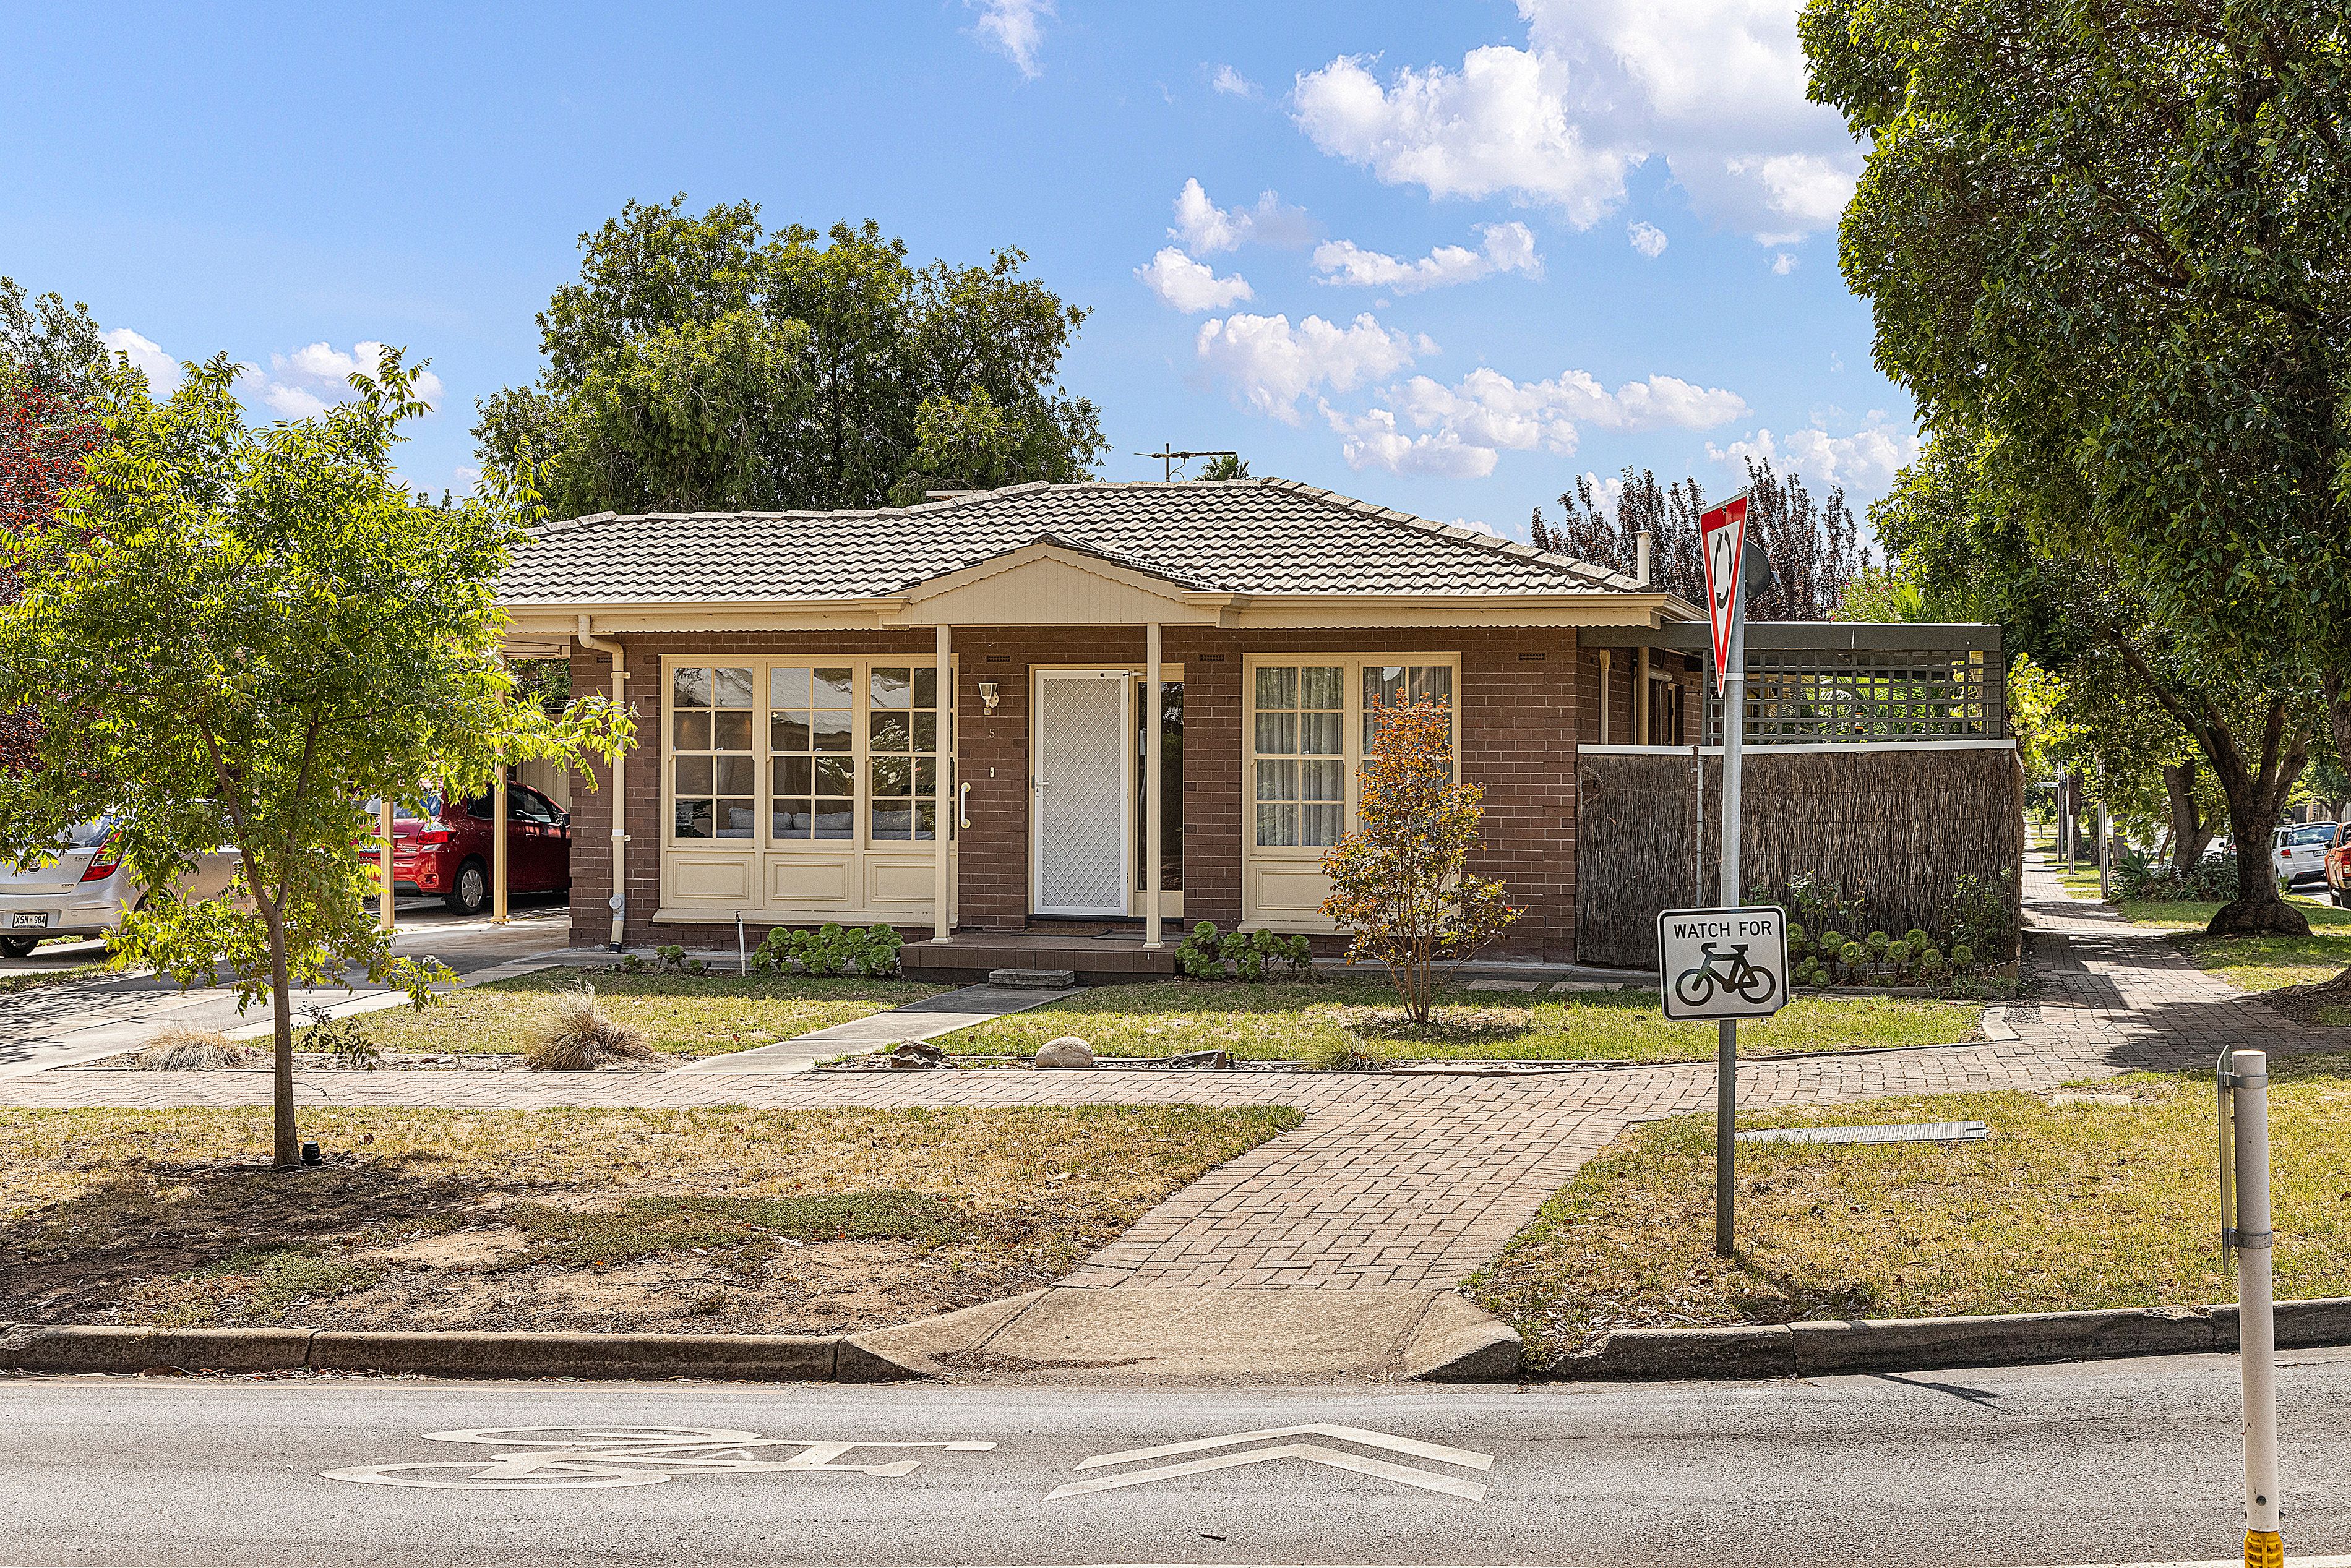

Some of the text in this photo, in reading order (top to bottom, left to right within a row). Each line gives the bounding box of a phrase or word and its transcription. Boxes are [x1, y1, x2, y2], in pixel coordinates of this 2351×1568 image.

[15, 915, 45, 924] XSN 984
[1674, 920, 1772, 939] WATCH FOR
